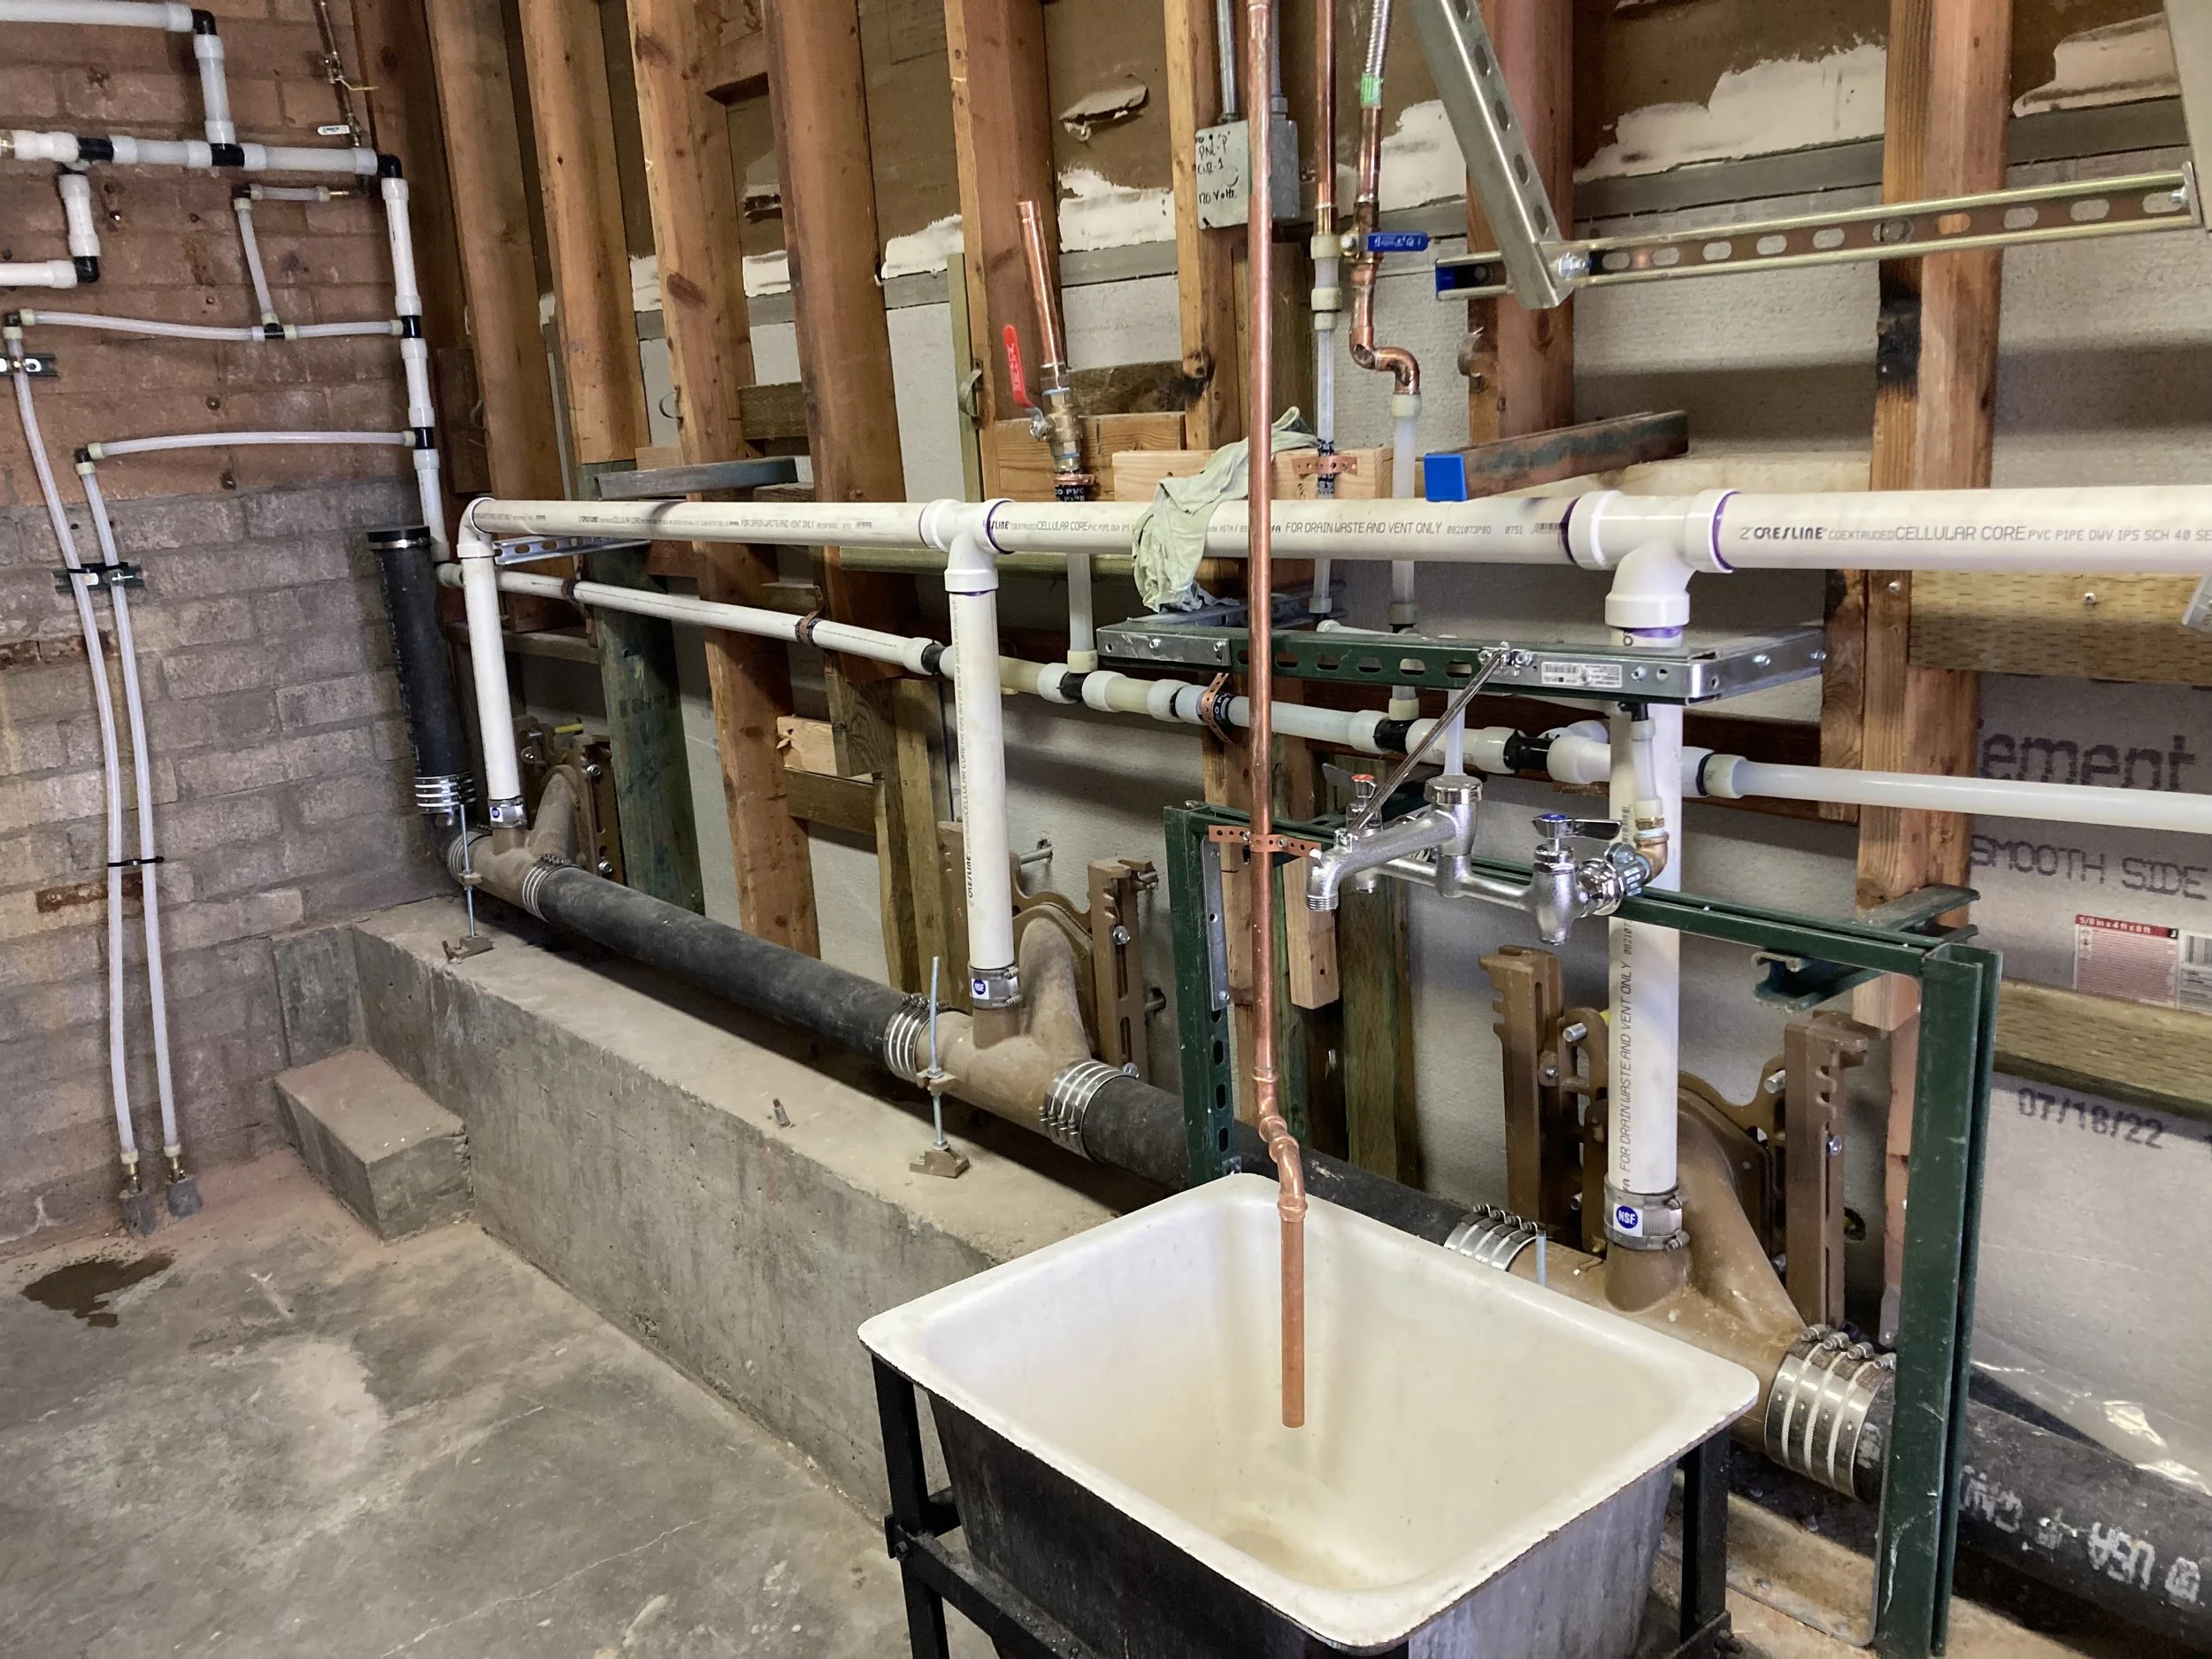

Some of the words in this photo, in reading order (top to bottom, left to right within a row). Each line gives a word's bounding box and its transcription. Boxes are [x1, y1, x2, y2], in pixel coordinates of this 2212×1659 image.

[989, 520, 1010, 530] SLINE
[1037, 520, 1069, 531] CELLULAR
[1070, 520, 1088, 531] CORE
[1286, 522, 1302, 533] FOR
[1304, 523, 1333, 534] DRAIN
[1334, 523, 1364, 534] WASTE
[1365, 523, 1386, 534] AND
[1388, 523, 1414, 534] VENT
[1416, 522, 1442, 534] ONLY
[1754, 526, 1824, 540] CRESLINE
[1827, 530, 1895, 541] COEXTRUDED
[1895, 526, 1976, 541] CELLULAR
[1981, 526, 2027, 541] CORE
[2027, 529, 2051, 541] PVC
[2055, 529, 2084, 541] PIPE
[2088, 529, 2114, 541] DWV
[2116, 529, 2140, 541] IPS
[2144, 529, 2170, 541] SCH
[2174, 529, 2192, 541] 40
[2194, 529, 2212, 541] SE
[959, 746, 968, 769] CORE
[1978, 733, 2195, 791] ement
[961, 770, 970, 815] CELLULAR
[1970, 833, 2105, 884] SMOOTH
[2123, 856, 2208, 901] SIDE
[2079, 917, 2094, 926] 5/8
[1621, 961, 1632, 995] ONLY
[1620, 998, 1632, 1030] VENT
[1620, 1033, 1632, 1061] AND
[1619, 1061, 1632, 1103] WASTE
[1619, 1104, 1632, 1144] DRAIN
[2018, 1087, 2163, 1149] 07/18/22
[1619, 1146, 1631, 1172] FOR
[1617, 1210, 1636, 1225] NSF
